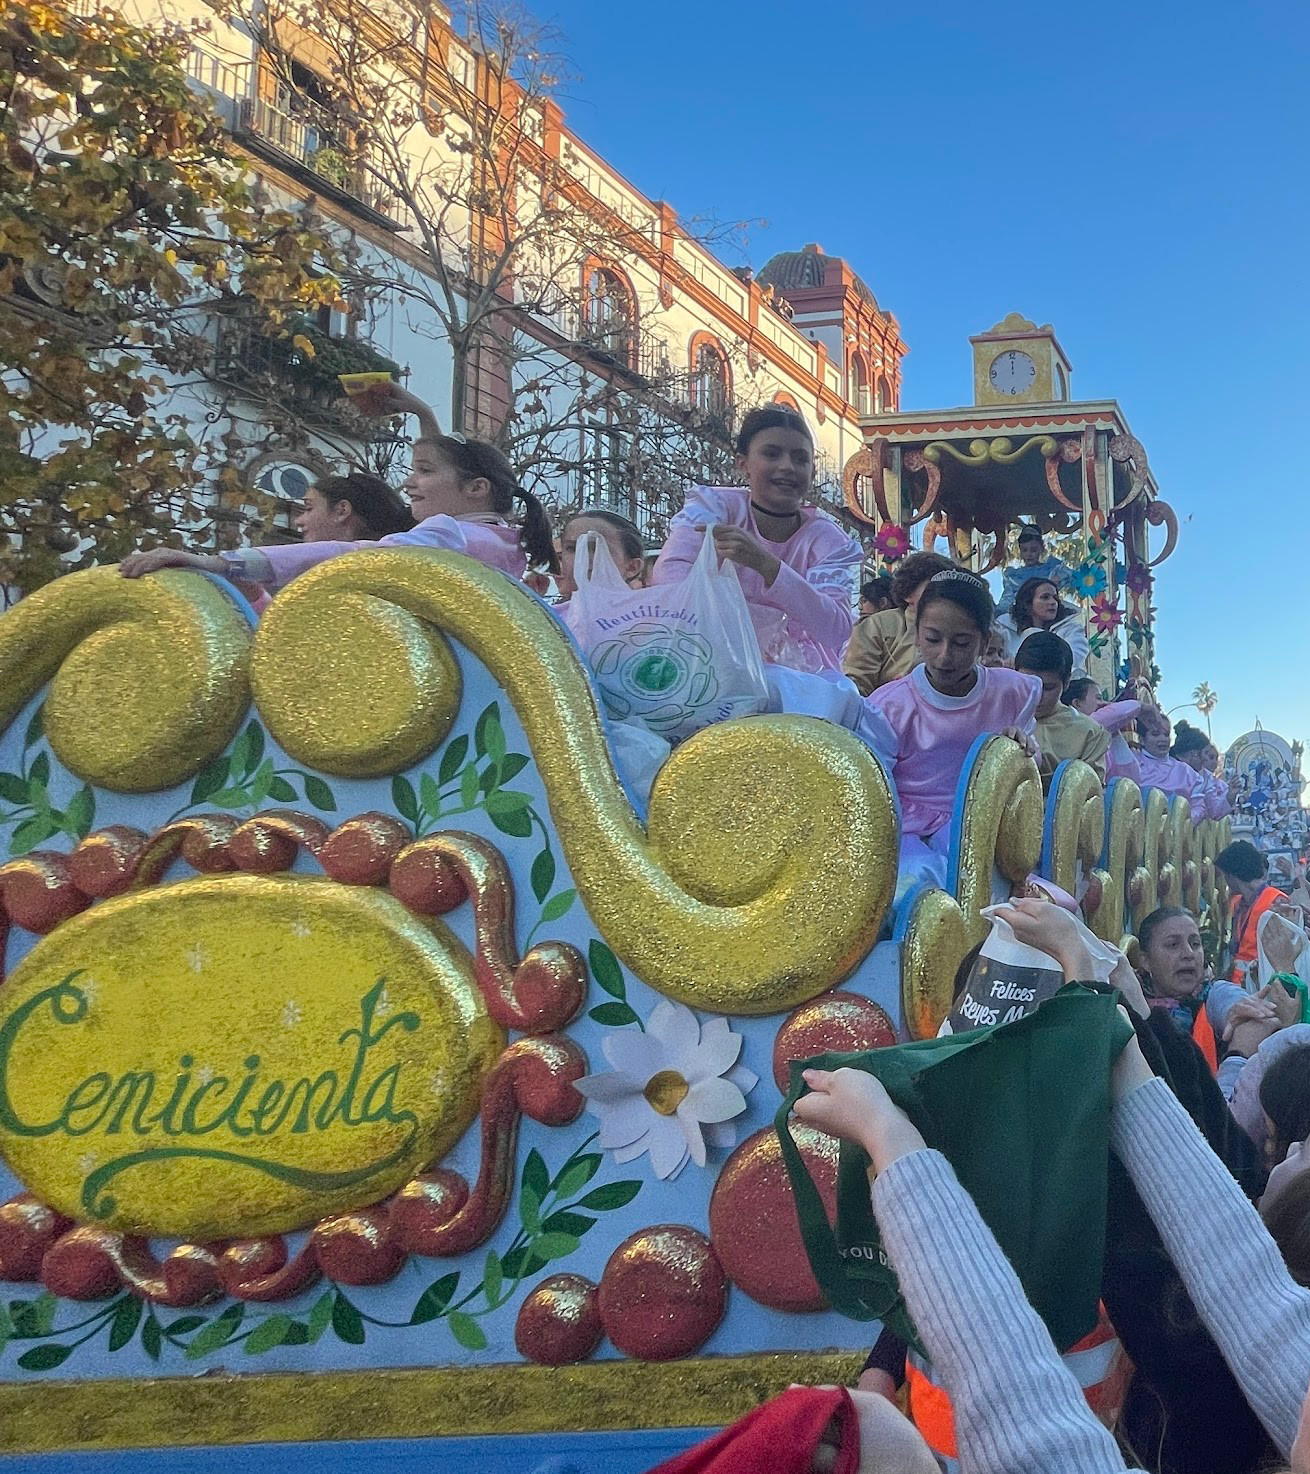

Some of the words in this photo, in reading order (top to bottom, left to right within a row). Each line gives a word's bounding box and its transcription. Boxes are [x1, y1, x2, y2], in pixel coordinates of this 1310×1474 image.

[1008, 352, 1016, 360] 12
[991, 370, 997, 379] 9
[1030, 366, 1036, 376] 3
[1010, 387, 1016, 395] 6
[990, 980, 1037, 1002] Felices
[960, 992, 1000, 1027] Reyes
[0, 968, 421, 1140] Cenicienta
